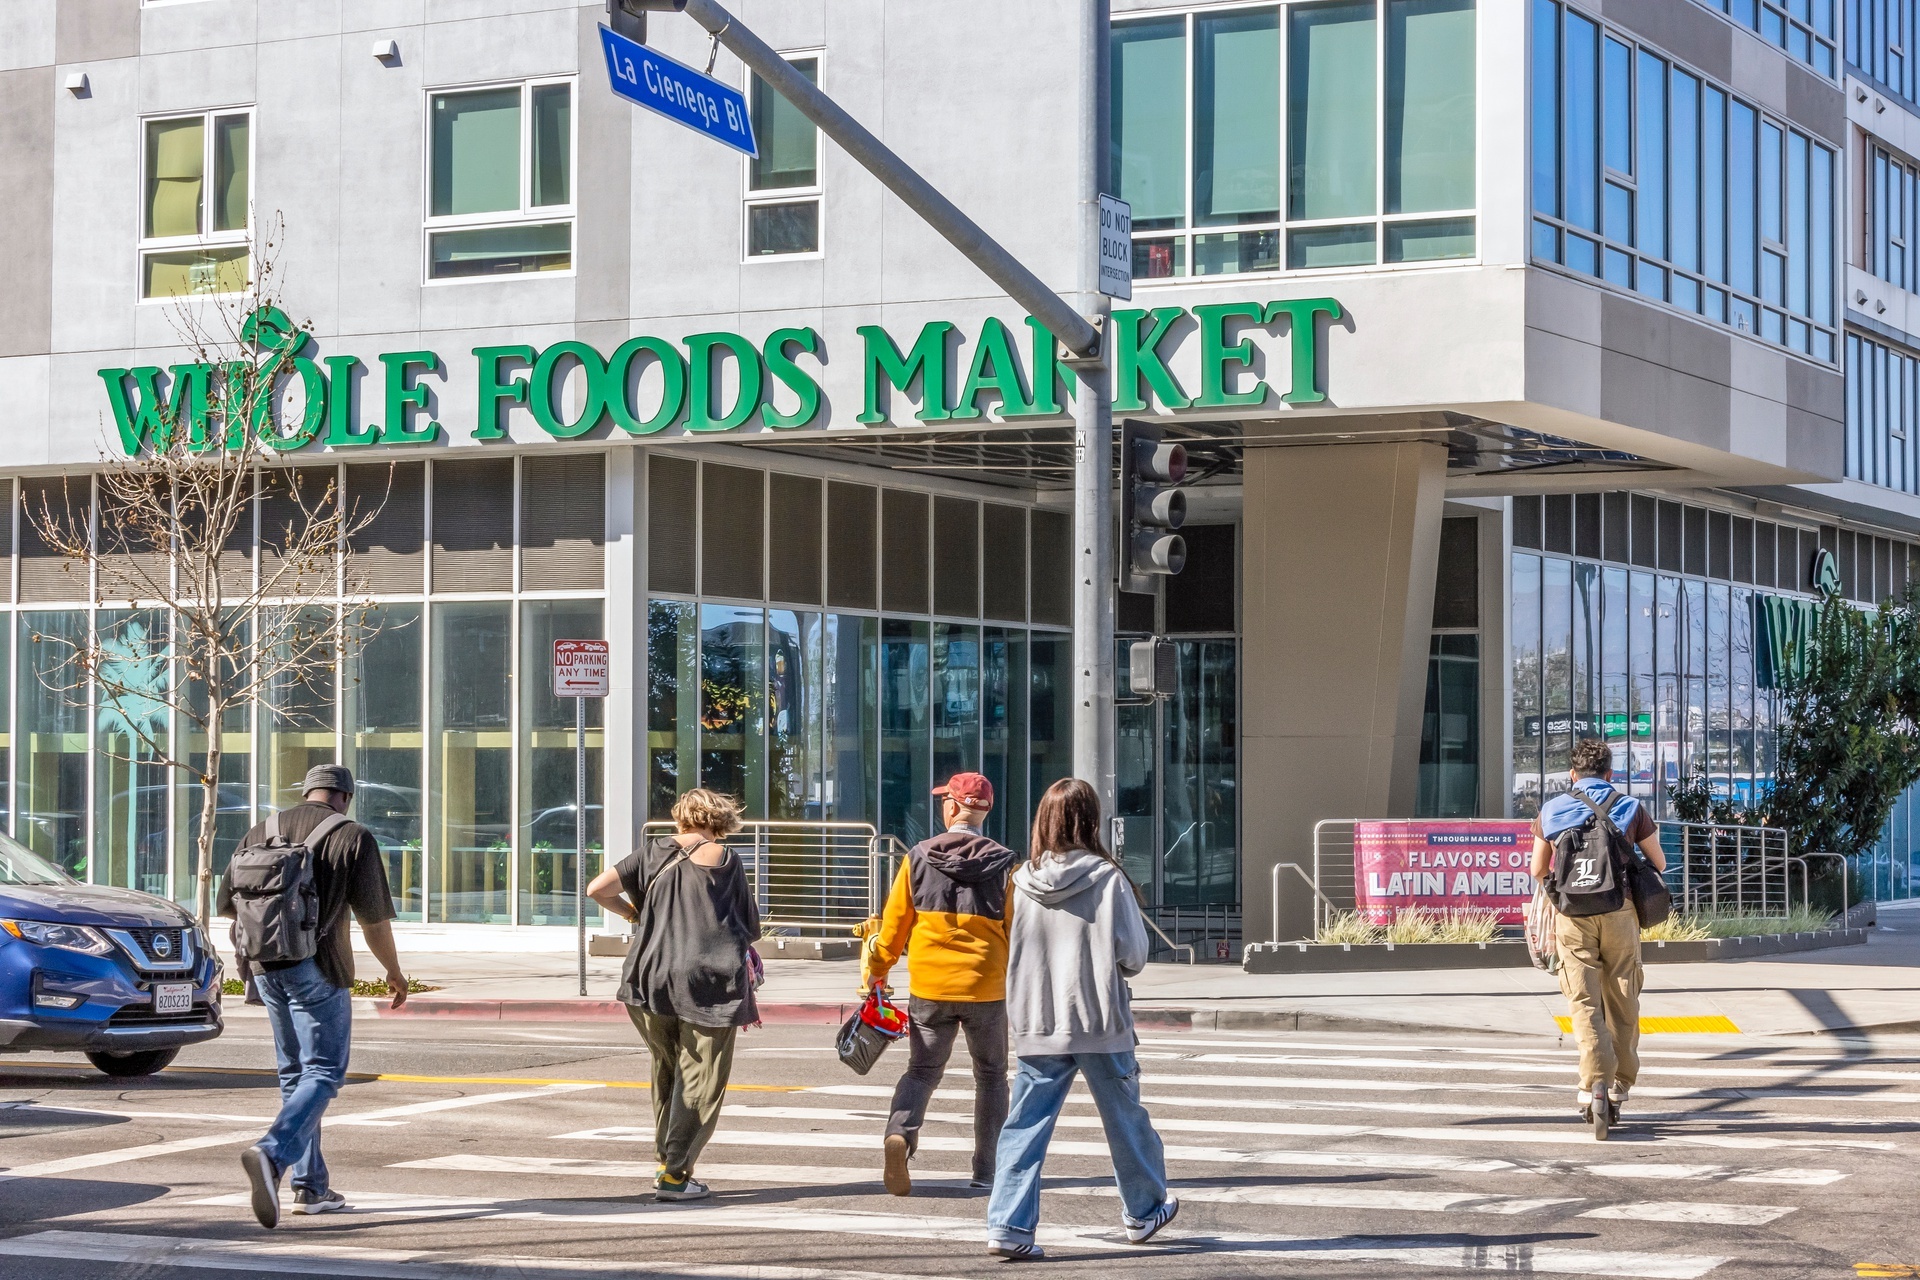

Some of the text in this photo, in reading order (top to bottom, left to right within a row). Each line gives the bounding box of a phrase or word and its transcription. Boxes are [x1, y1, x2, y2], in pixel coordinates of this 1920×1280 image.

[611, 43, 745, 135] La Cienega Bl
[1101, 207, 1130, 235] DO NOT
[1102, 237, 1128, 262] BLOCK
[1101, 264, 1130, 283] INTERSECTION
[98, 345, 439, 457] WHOLE
[470, 326, 821, 440] FOODS
[556, 651, 607, 665] NO PARKING
[558, 668, 606, 677] ANY TIME
[1408, 851, 1532, 868] FLAVORS OF
[1574, 858, 1600, 881] L
[1368, 872, 1446, 896] LATIN
